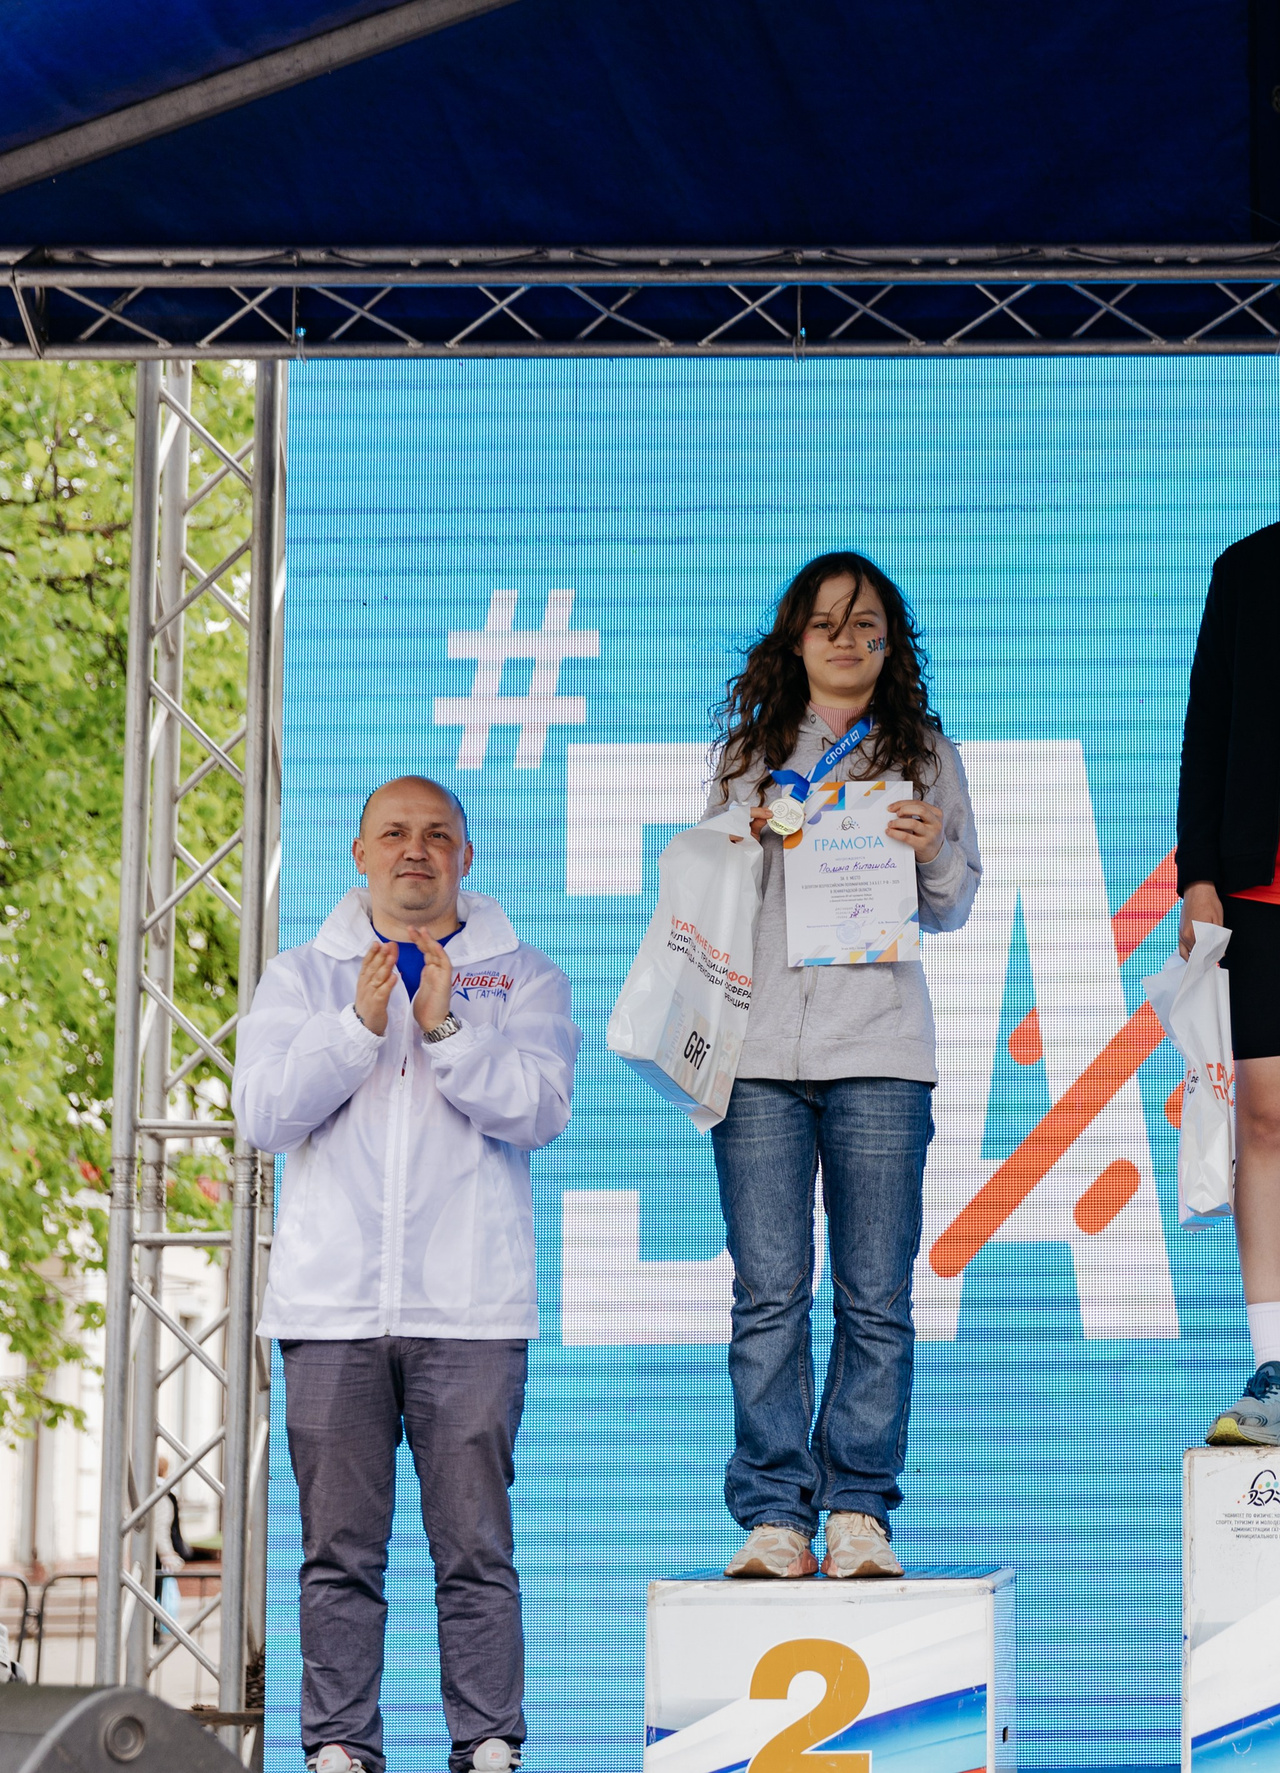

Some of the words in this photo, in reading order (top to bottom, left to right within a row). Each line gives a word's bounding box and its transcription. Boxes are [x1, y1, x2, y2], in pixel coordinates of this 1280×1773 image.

[825, 738, 851, 765] СПОРТ
[814, 836, 884, 851] ГРАМОТА
[675, 919, 708, 951] ГАТИНЕ
[461, 974, 514, 990] ПОБЕДЫ
[683, 1030, 711, 1070] GRi
[747, 1637, 872, 1773] 2
